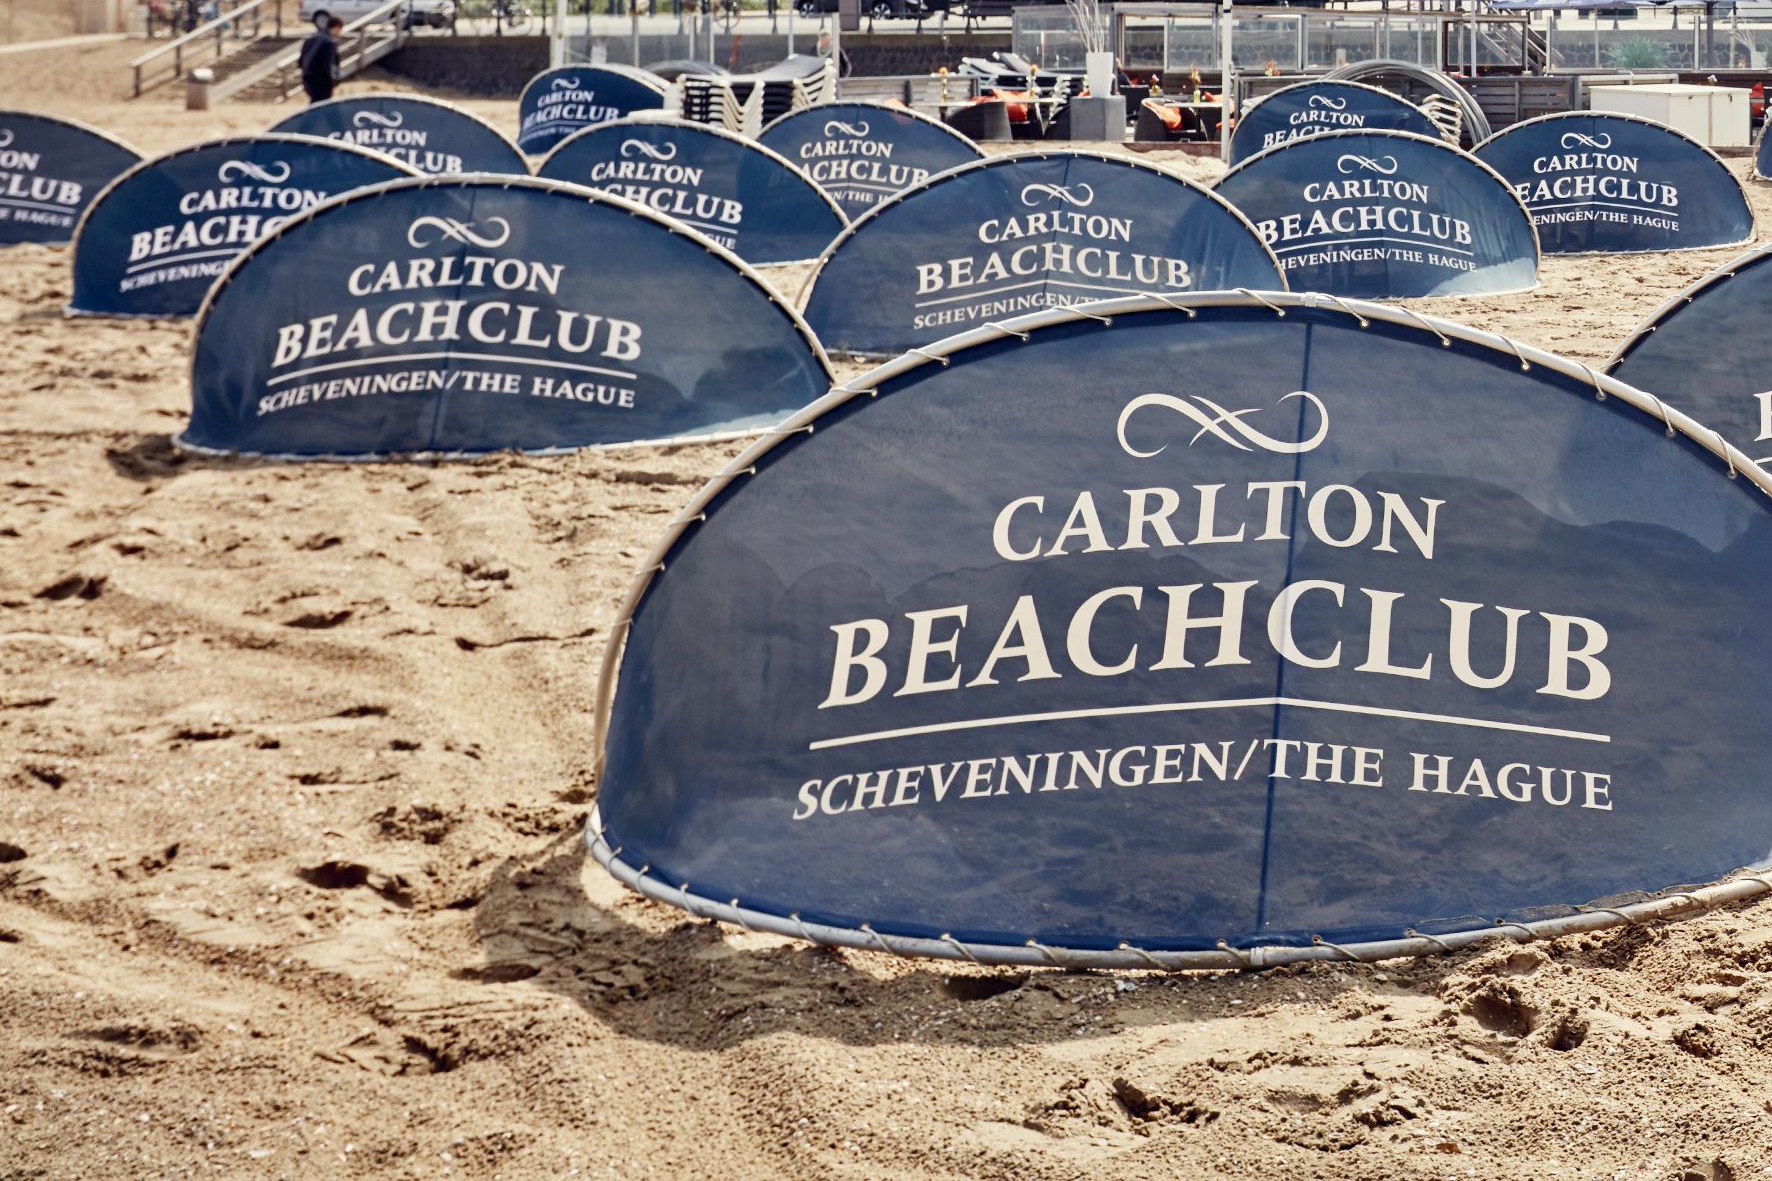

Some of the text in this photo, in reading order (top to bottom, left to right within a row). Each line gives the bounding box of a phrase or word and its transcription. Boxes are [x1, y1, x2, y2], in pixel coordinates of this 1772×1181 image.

[1290, 109, 1365, 127] CARLTON
[800, 139, 894, 159] CARLTON
[1533, 152, 1639, 174] CARLTON
[591, 161, 704, 187] CARLTON
[180, 186, 328, 215] CARLTON
[1303, 179, 1429, 204] CARLTON
[979, 210, 1133, 243] CARLTON
[1257, 206, 1472, 246] BEACHCLUB
[1633, 215, 1680, 232] HAGUE
[348, 256, 565, 296] CARLTON
[915, 242, 1192, 295] BEACHCLUB
[1428, 253, 1478, 273] HAGUE
[271, 300, 642, 369] BEACHCLUB
[256, 370, 635, 417] SCHEVENINGEN/THE HAGUE
[993, 480, 1447, 562] CARLTON
[817, 580, 1613, 710] BEACHCLUB
[793, 737, 1613, 820] SCHEVENINGEN/THE HAGUE
